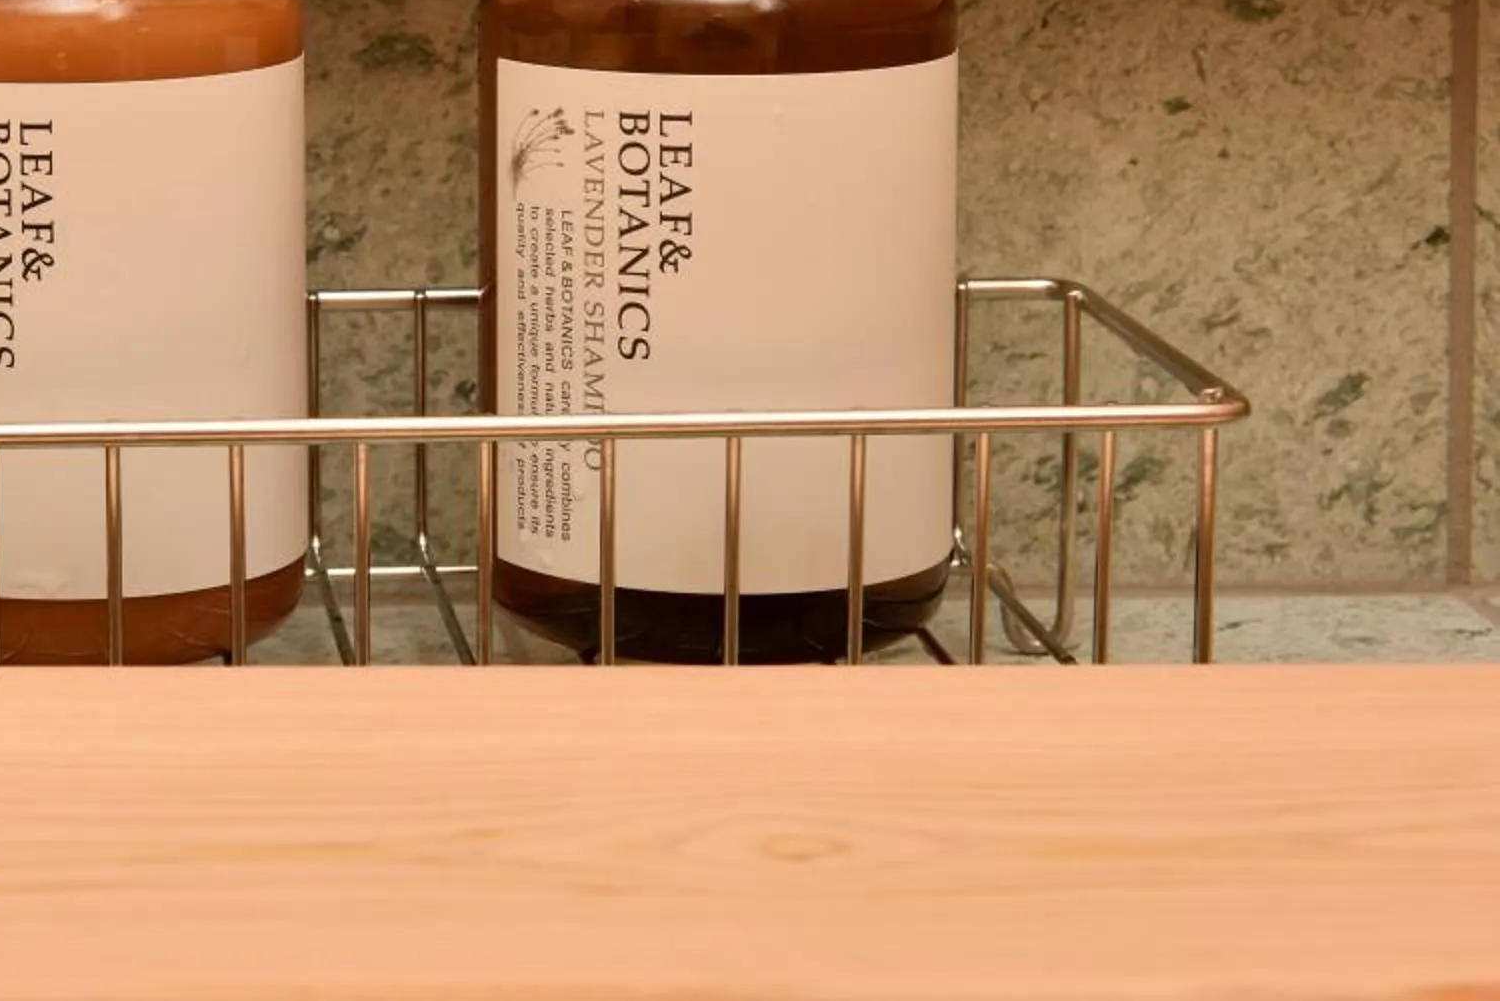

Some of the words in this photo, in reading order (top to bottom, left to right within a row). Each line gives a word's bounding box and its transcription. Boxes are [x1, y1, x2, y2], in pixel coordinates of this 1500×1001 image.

[20, 120, 55, 282] LEAF&
[583, 111, 605, 289] LAVENDER
[659, 110, 693, 274] LEAF&
[545, 208, 555, 277] selected
[561, 210, 574, 257] LEAF
[618, 110, 651, 360] BOTANICS
[517, 268, 527, 300] and
[531, 285, 539, 296] a
[561, 260, 573, 272] &
[528, 302, 540, 357] unique
[545, 286, 556, 332] herbs
[561, 276, 573, 371] BOTANICS
[545, 342, 556, 373] and
[561, 462, 573, 542] combines
